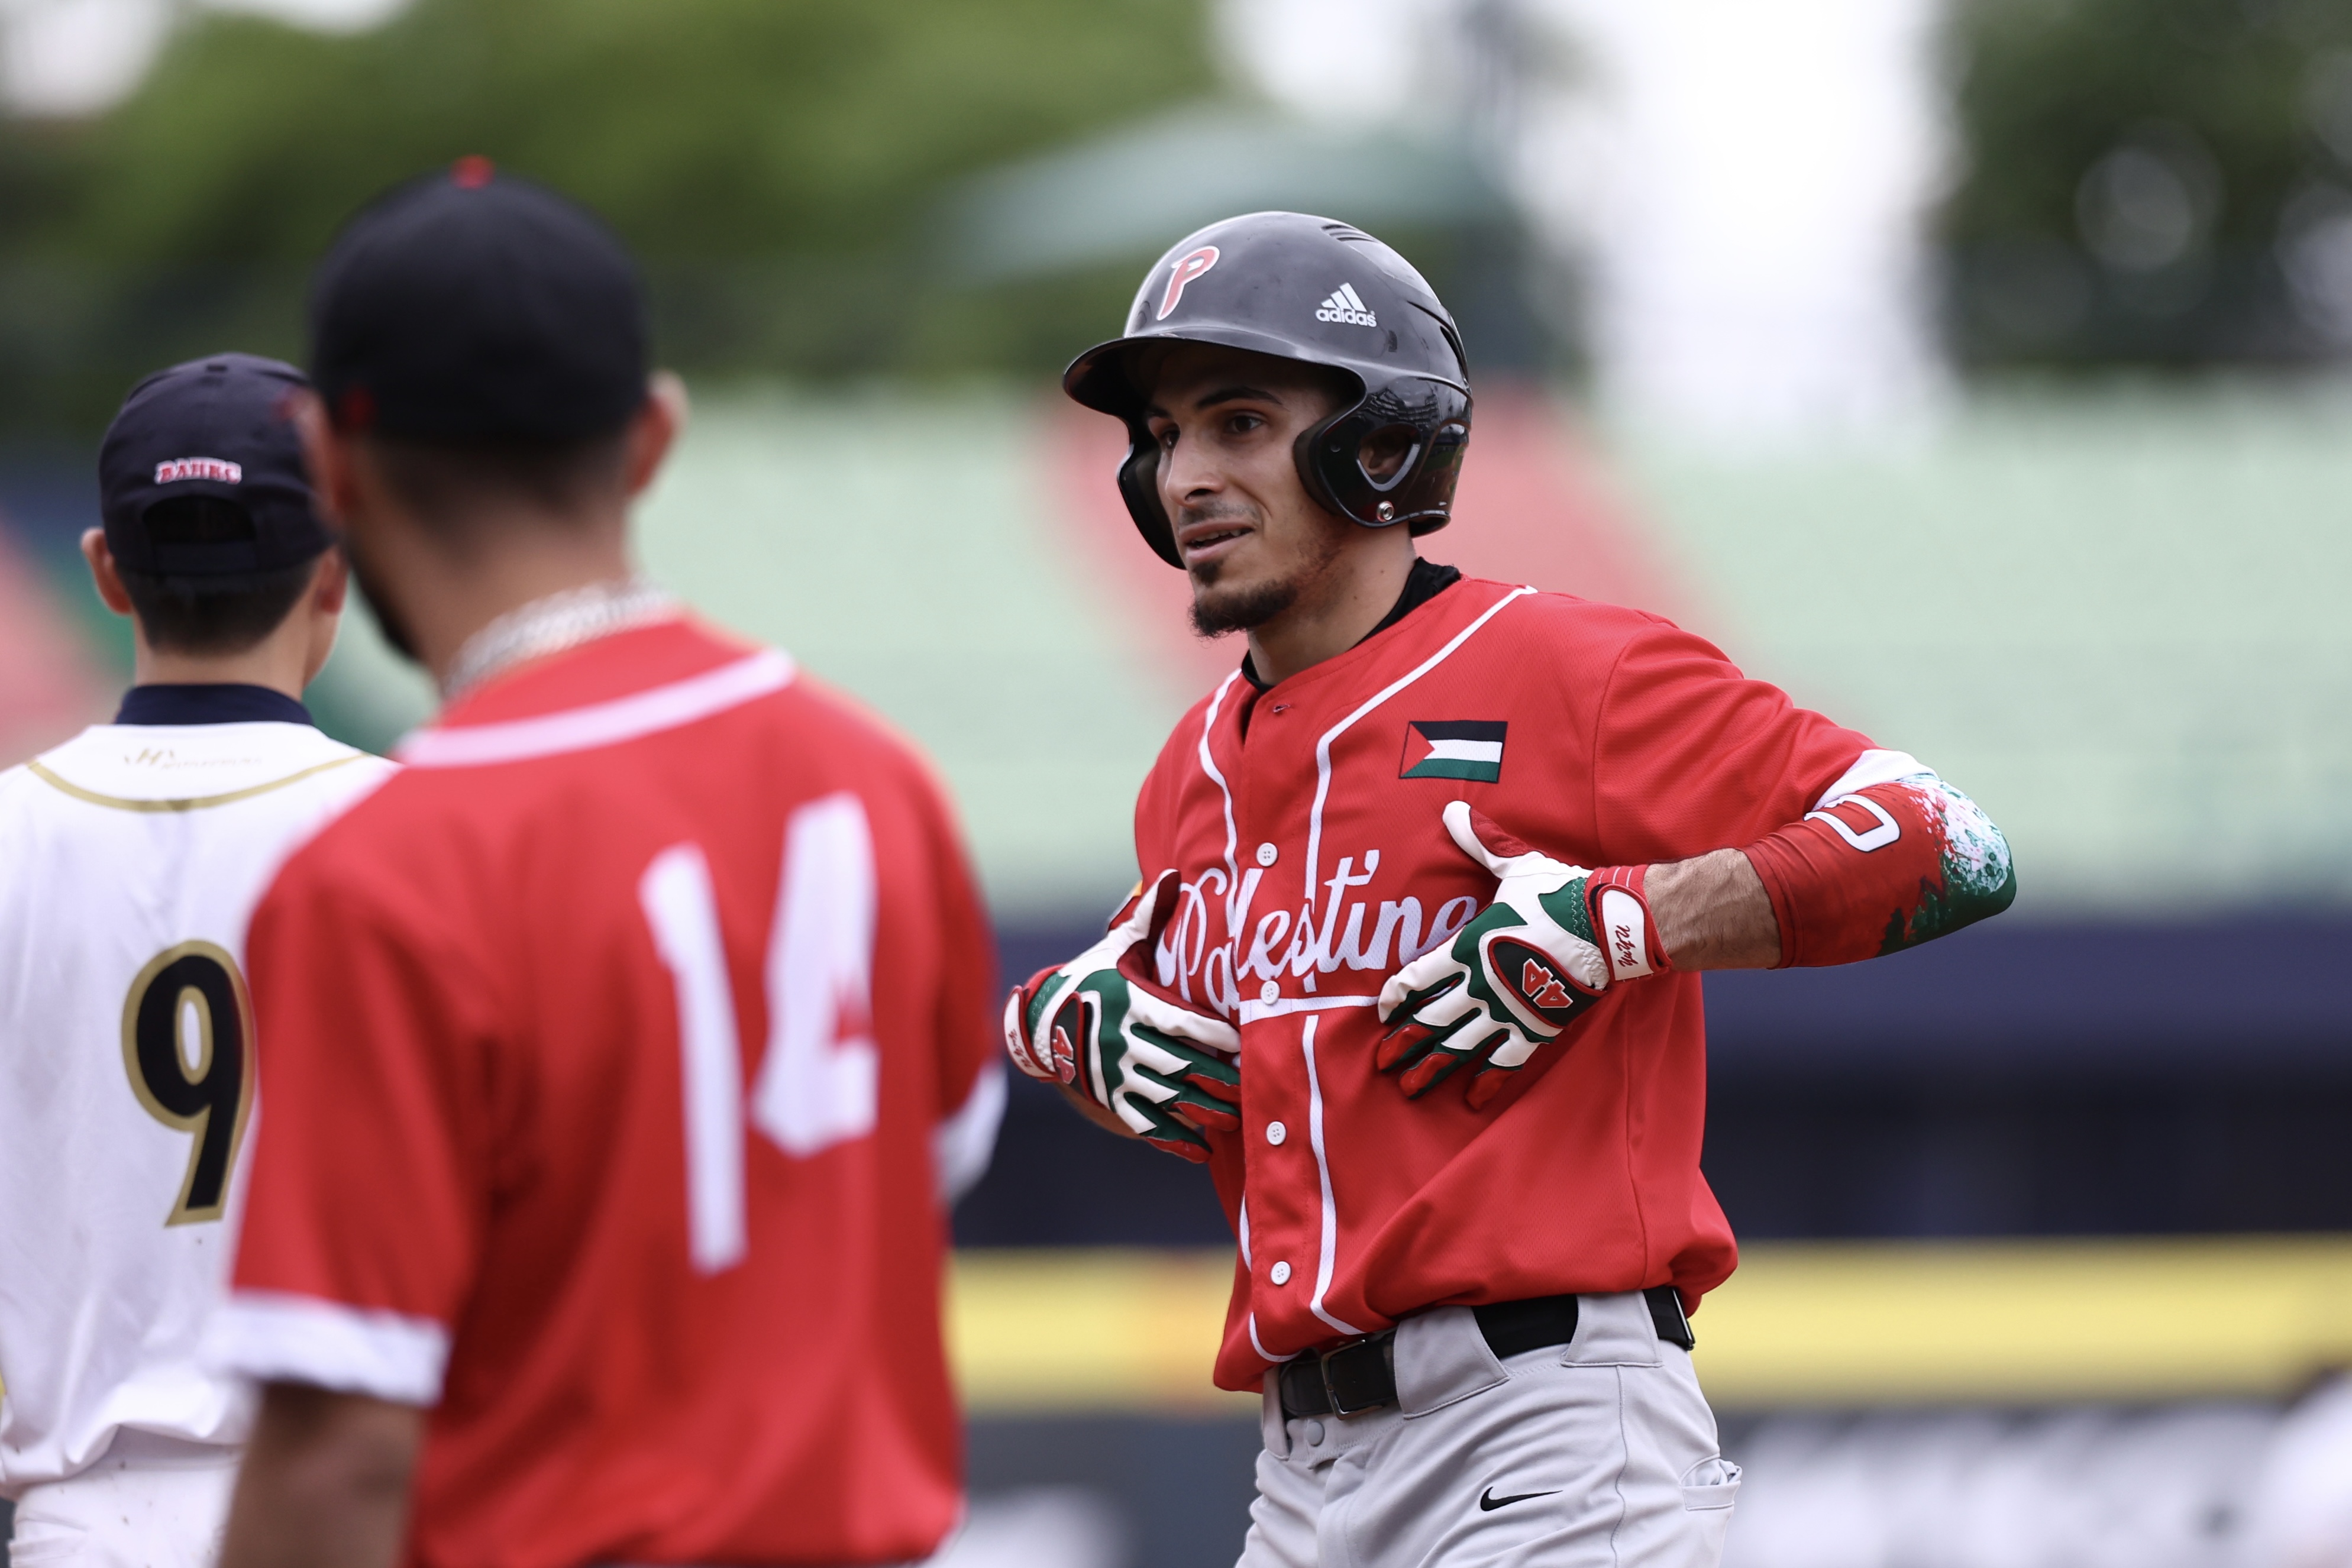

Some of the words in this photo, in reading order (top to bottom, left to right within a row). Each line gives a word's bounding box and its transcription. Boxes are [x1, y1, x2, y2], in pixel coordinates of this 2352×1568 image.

[1155, 245, 1220, 321] P
[1314, 306, 1377, 328] adidas
[1155, 849, 1478, 1019] Palestine
[1522, 958, 1574, 1008] 44
[121, 939, 257, 1228] 9
[638, 789, 880, 1276] 14
